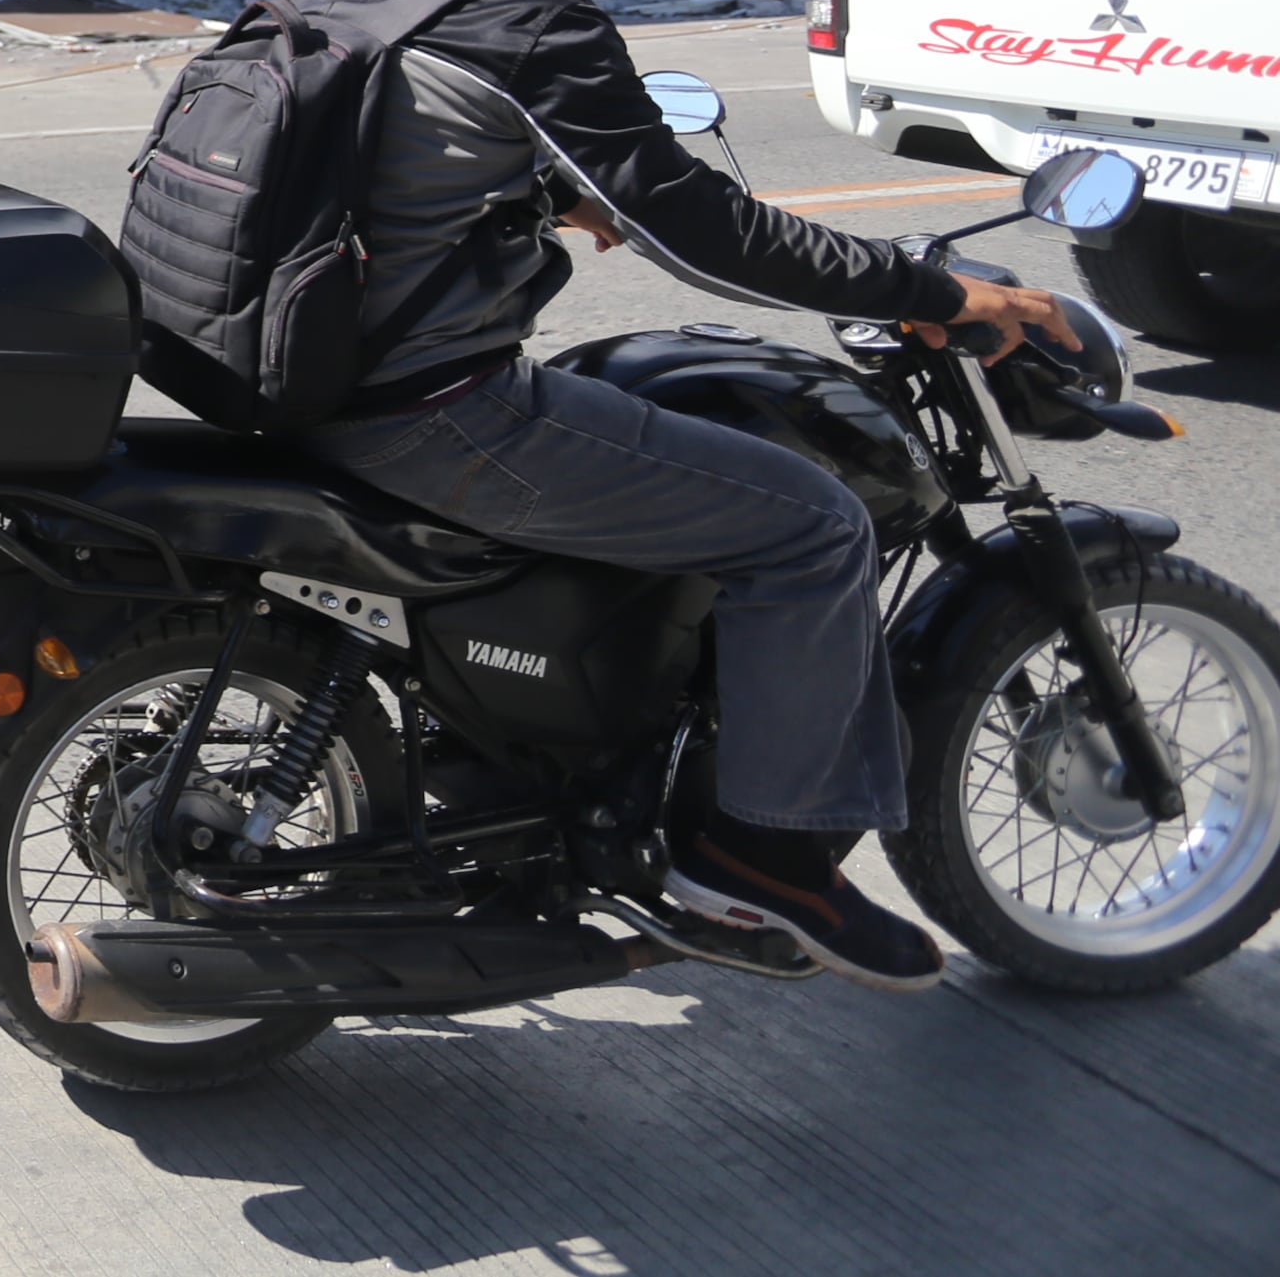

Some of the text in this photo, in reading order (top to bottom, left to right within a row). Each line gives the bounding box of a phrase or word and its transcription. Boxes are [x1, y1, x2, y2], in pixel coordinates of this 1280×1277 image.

[918, 18, 1057, 66] Stay
[1143, 154, 1232, 195] 8795
[466, 639, 548, 679] YAMAHA
